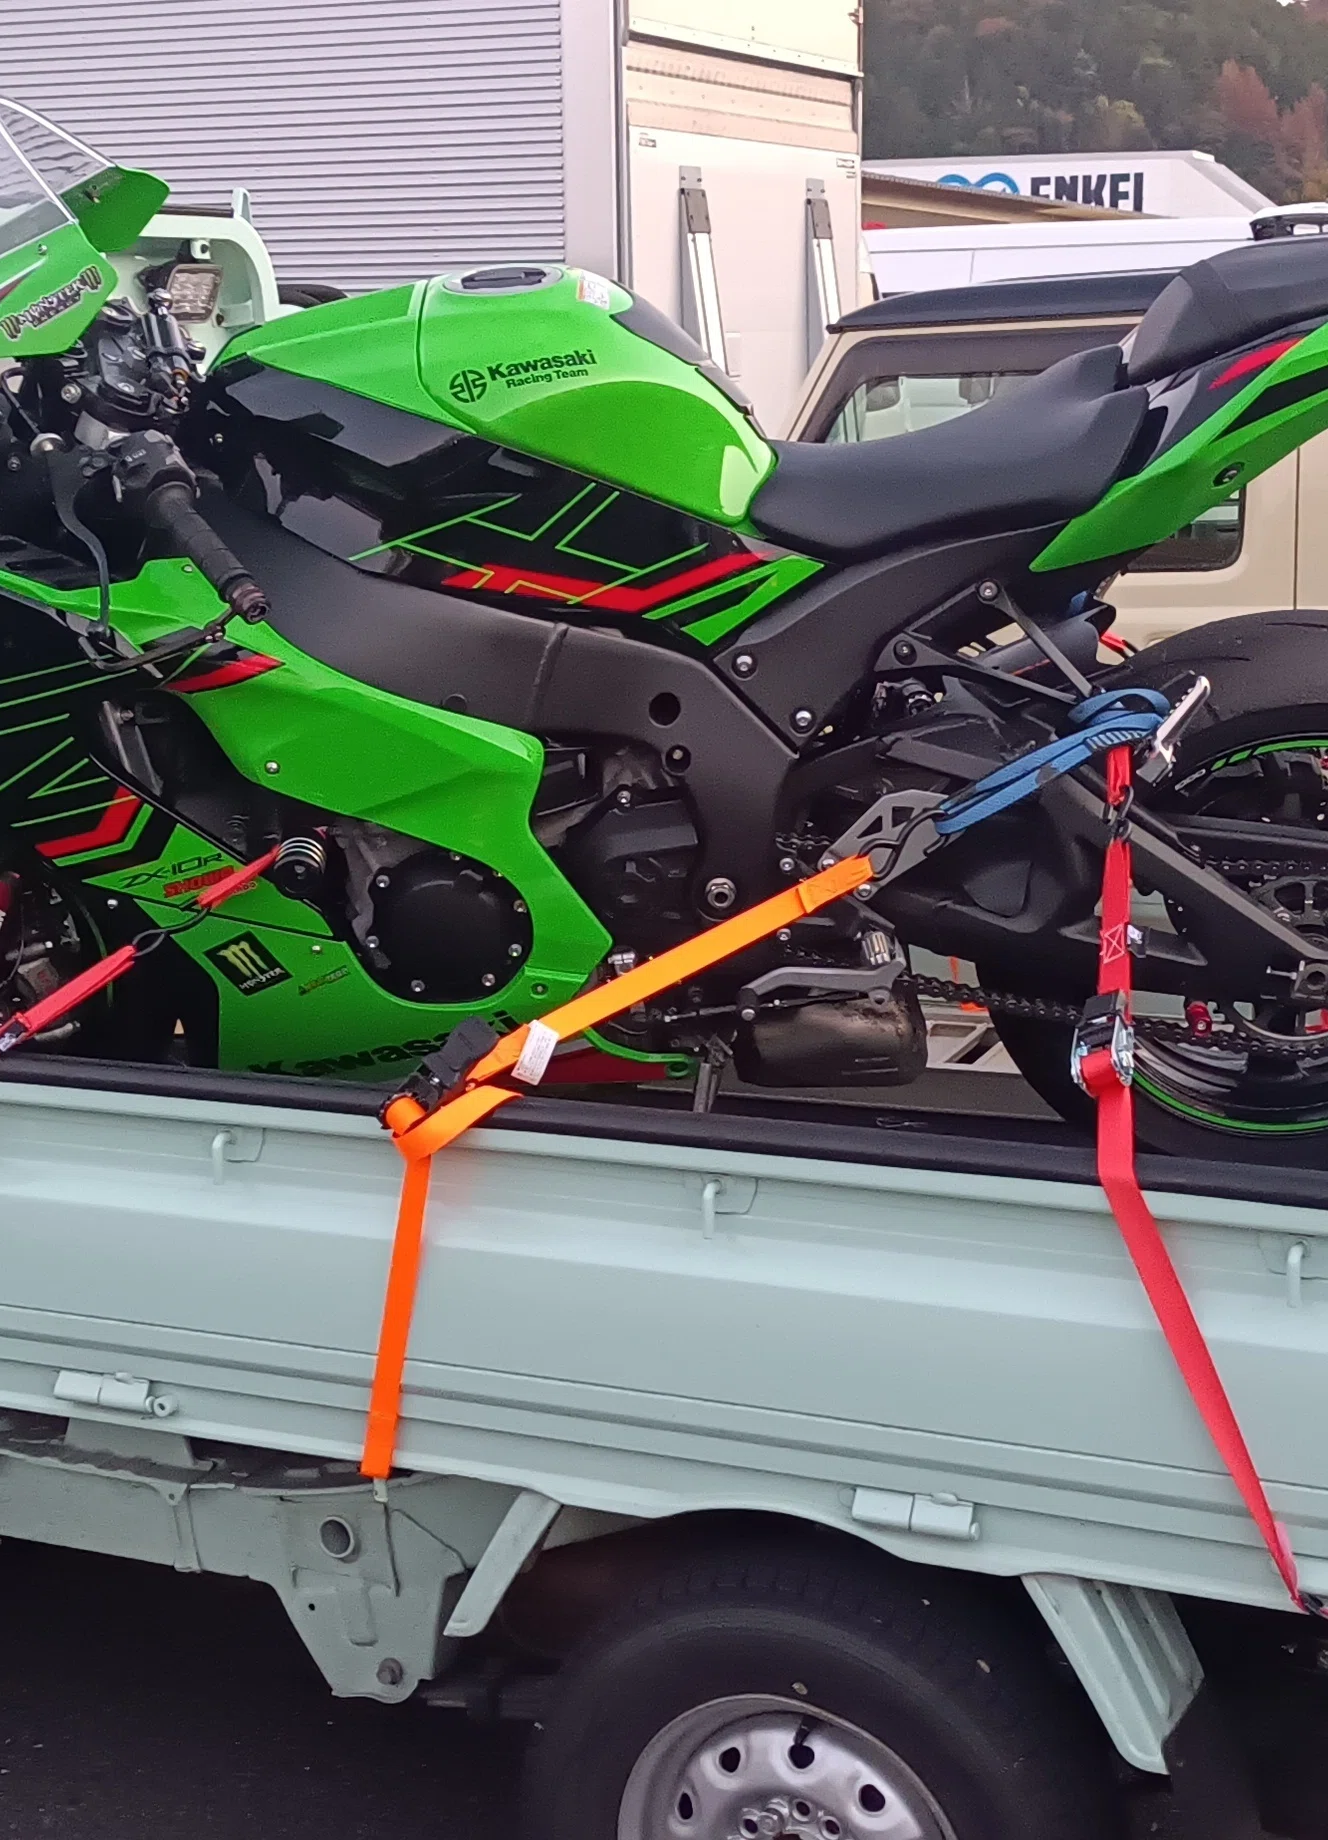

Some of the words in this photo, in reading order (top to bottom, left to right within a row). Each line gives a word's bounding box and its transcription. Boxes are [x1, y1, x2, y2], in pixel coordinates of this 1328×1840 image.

[487, 349, 597, 382] Kawasaki
[505, 373, 553, 389] Racing
[553, 368, 589, 381] Team
[119, 852, 225, 889] ZX-10R
